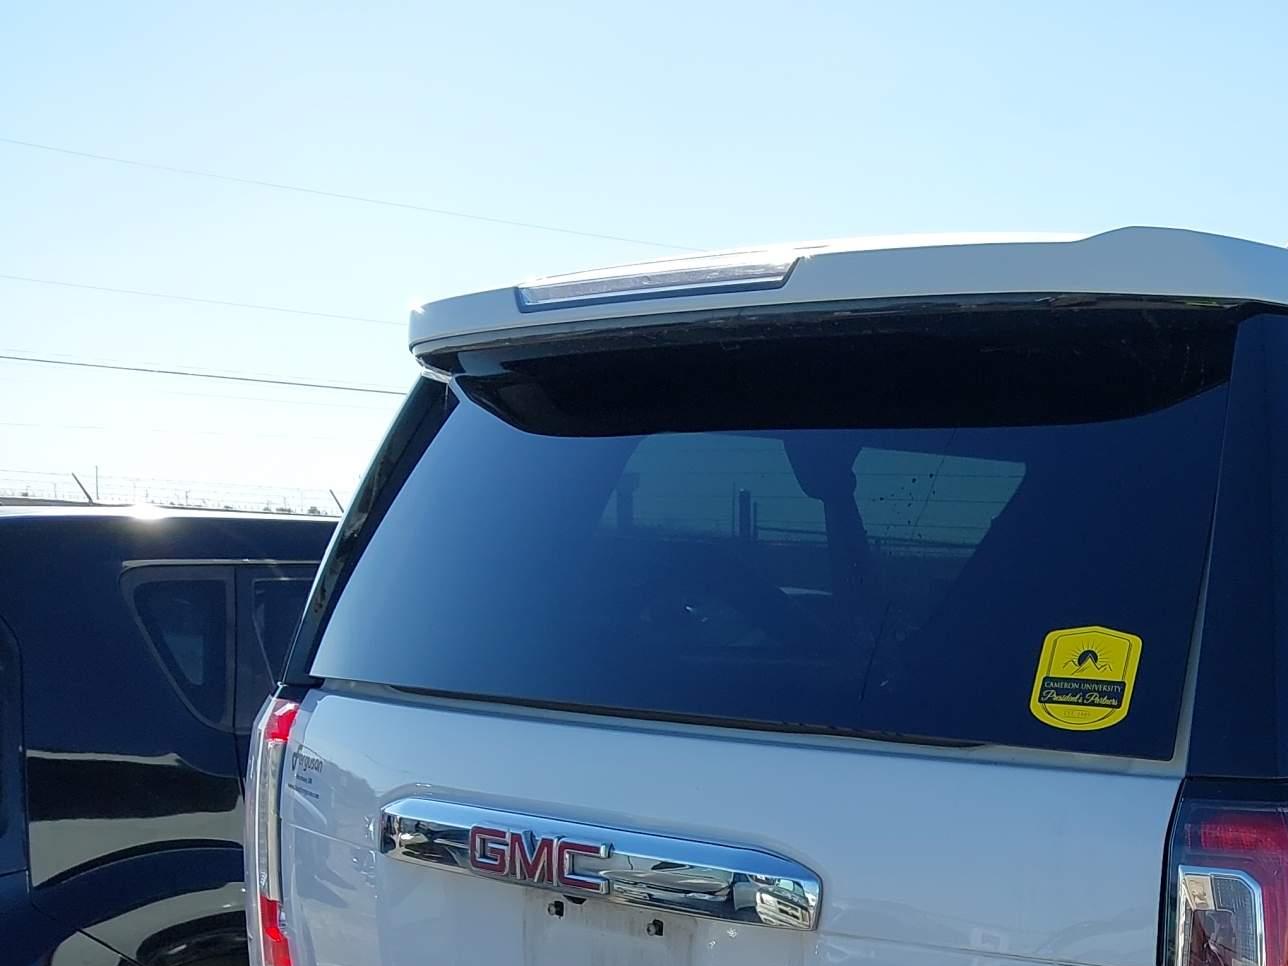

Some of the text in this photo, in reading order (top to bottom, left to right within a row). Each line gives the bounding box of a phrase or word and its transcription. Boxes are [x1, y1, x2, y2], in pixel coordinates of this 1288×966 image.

[1045, 681, 1121, 693] CAMERON UNIVERSITY
[469, 824, 615, 895] GMC
